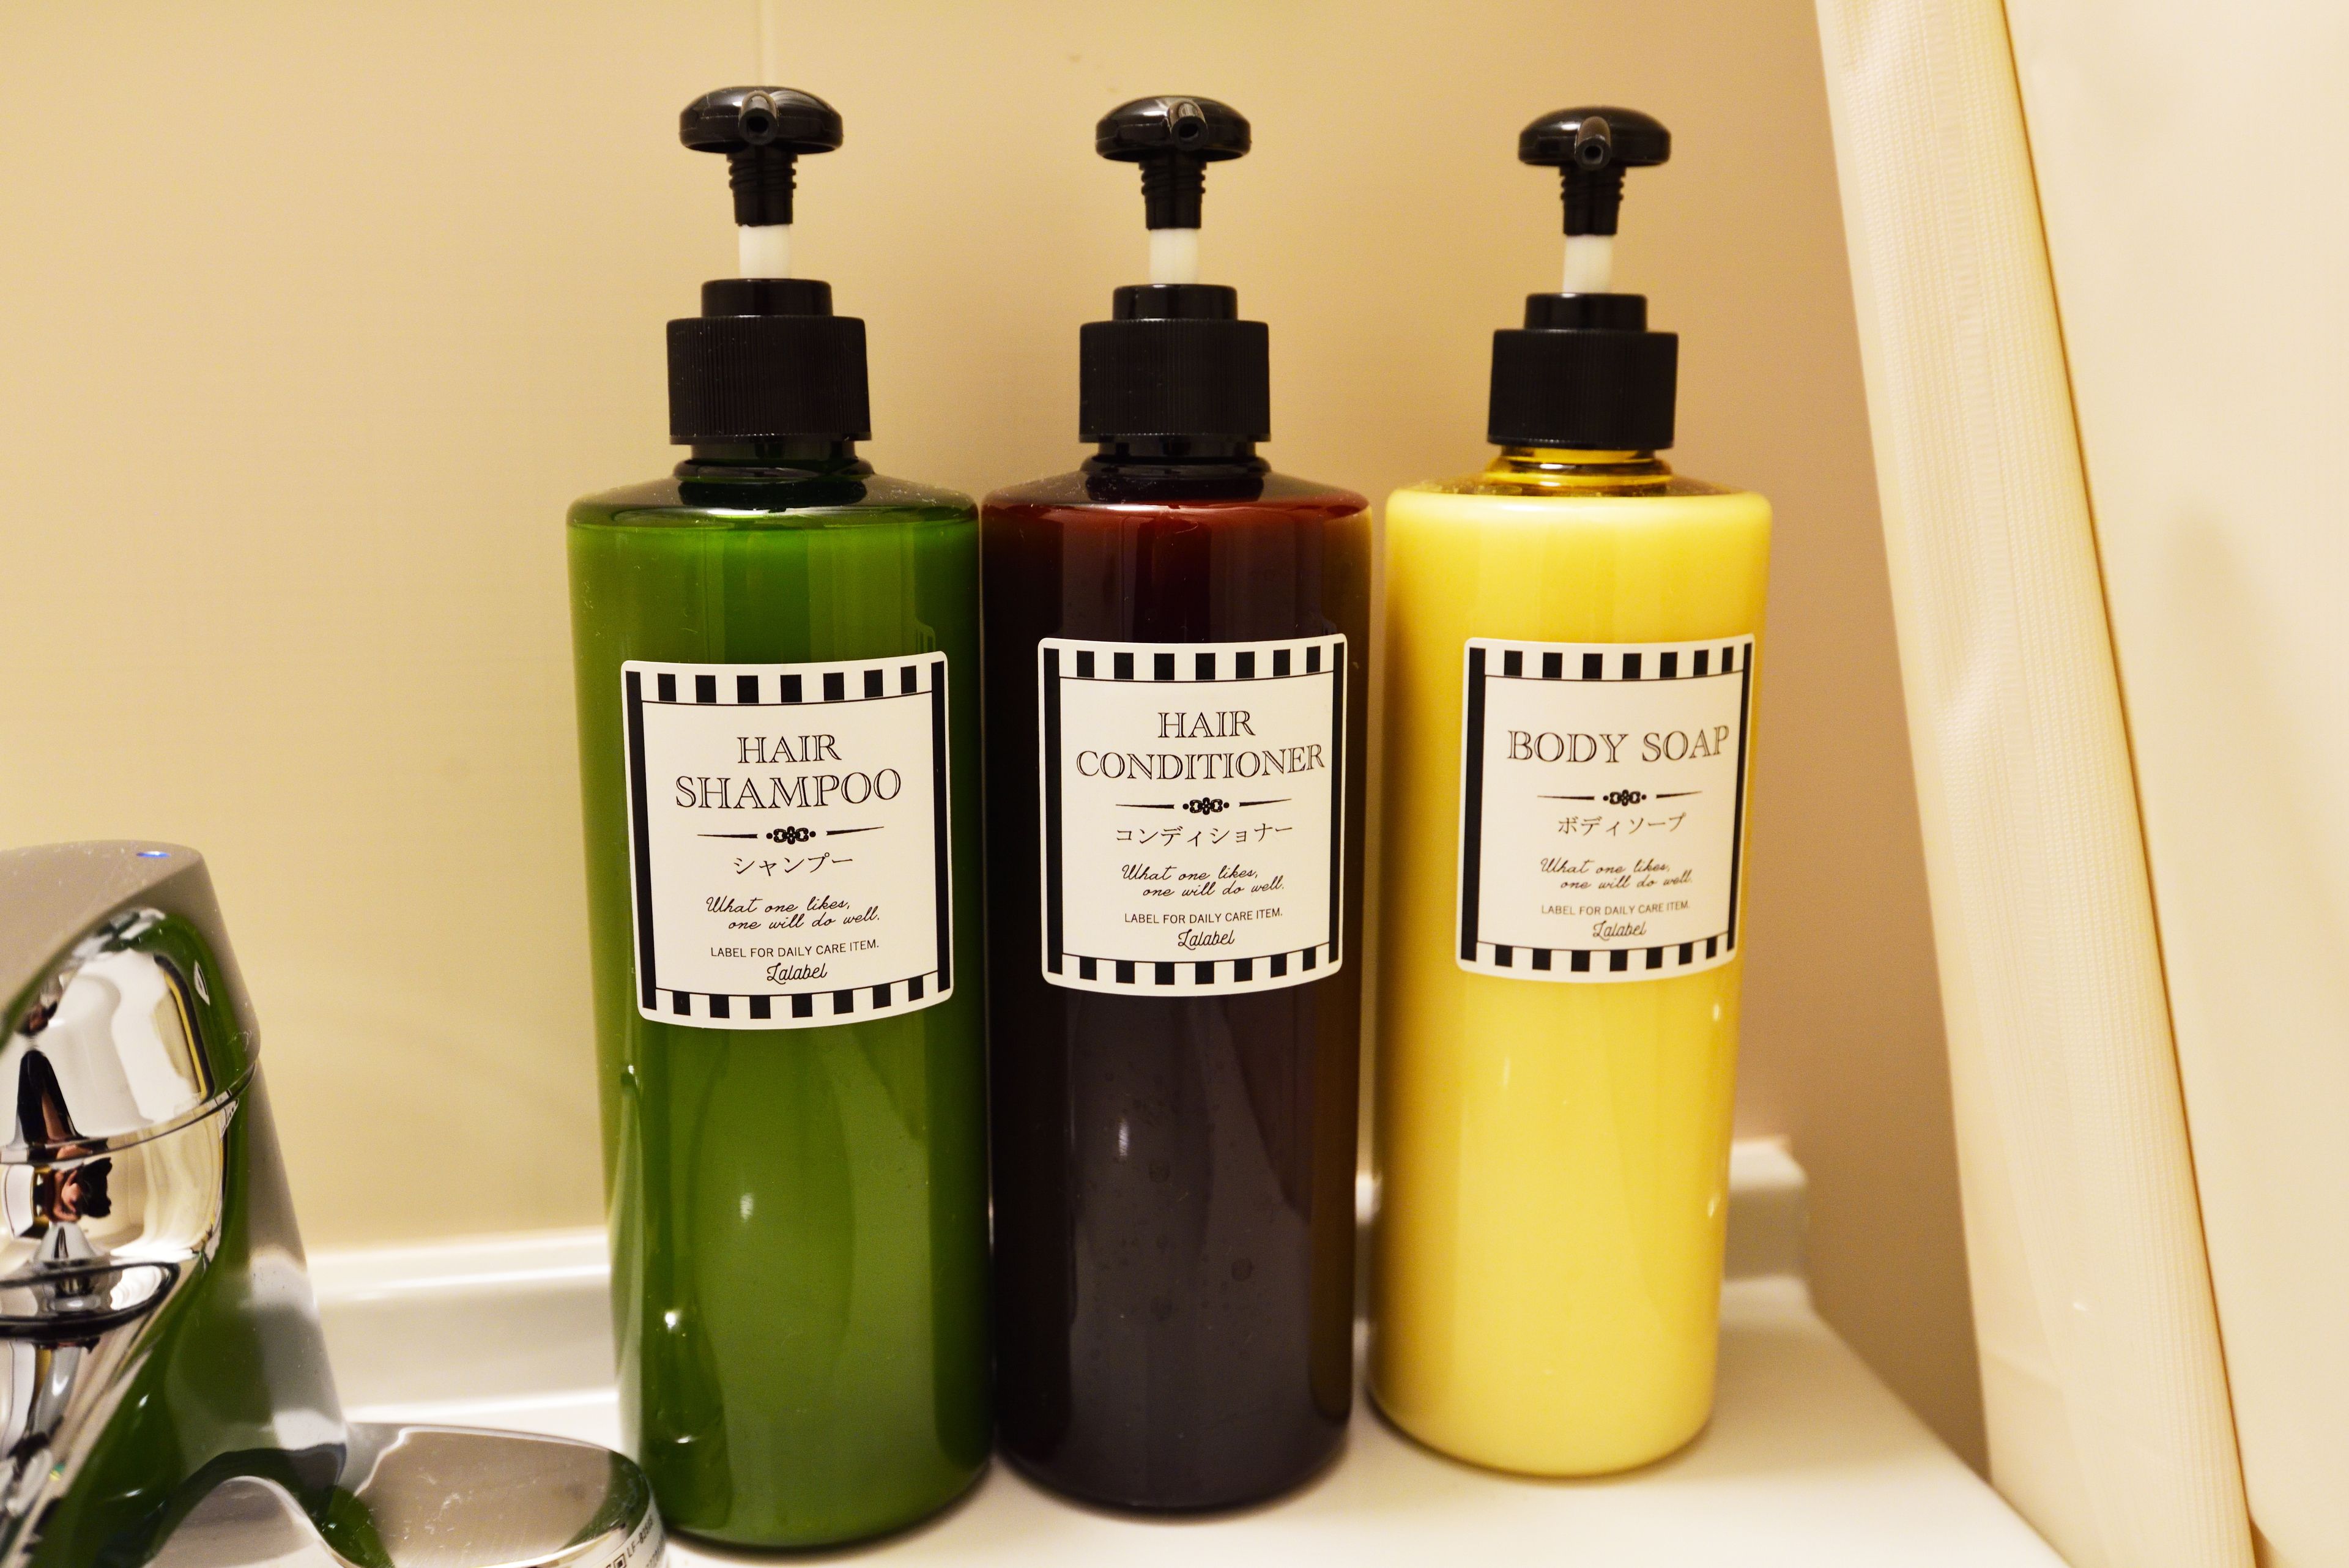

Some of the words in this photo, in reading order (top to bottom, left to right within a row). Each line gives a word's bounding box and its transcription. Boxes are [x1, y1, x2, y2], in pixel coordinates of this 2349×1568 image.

[1157, 710, 1256, 738] HAIR
[737, 734, 842, 764] HAIR
[1507, 730, 1629, 764] BODY
[1642, 725, 1730, 762] SOAP
[1076, 743, 1326, 780] CONDITIONER
[675, 768, 901, 809] SHAMPOO
[1116, 823, 1293, 847] コンディショナー
[1558, 812, 1687, 838] ボディソープ
[733, 852, 853, 877] シャンプー
[1121, 863, 1177, 881] What
[1178, 871, 1211, 881] one
[1217, 863, 1258, 880] likes,
[1540, 857, 1594, 874] What
[1595, 865, 1626, 874] one
[1633, 858, 1670, 873] likes,
[1142, 888, 1175, 897] one
[1181, 881, 1217, 897] will
[1222, 879, 1245, 896] do
[1250, 874, 1284, 893] well.
[1560, 880, 1592, 890] one
[1598, 874, 1631, 890] will
[1636, 874, 1657, 888] do
[1663, 869, 1693, 886] well.
[706, 895, 763, 913] What
[764, 904, 799, 913] one
[806, 894, 850, 912] likes,
[1541, 905, 1576, 916] LABEL
[1579, 906, 1601, 916] FOR
[1605, 905, 1635, 916] DAILY
[1638, 903, 1664, 914] CARE
[1666, 900, 1690, 912] ITEM.
[728, 920, 762, 930] one
[768, 913, 806, 929] will
[811, 911, 837, 927] do
[842, 905, 880, 924] well.
[1124, 913, 1160, 924] LABEL
[1163, 914, 1186, 924] FOR
[1189, 913, 1222, 924] DAILY
[1225, 910, 1253, 923] CARE
[1256, 907, 1283, 920] ITEM.
[1178, 928, 1236, 951] Lalabel
[1592, 920, 1647, 942] Lalabel
[711, 946, 746, 958] LABEL
[751, 947, 774, 958] FOR
[777, 946, 812, 957] DAILY
[816, 943, 847, 955] CARE
[850, 938, 879, 952] ITEM.
[766, 962, 828, 985] Lalabel
